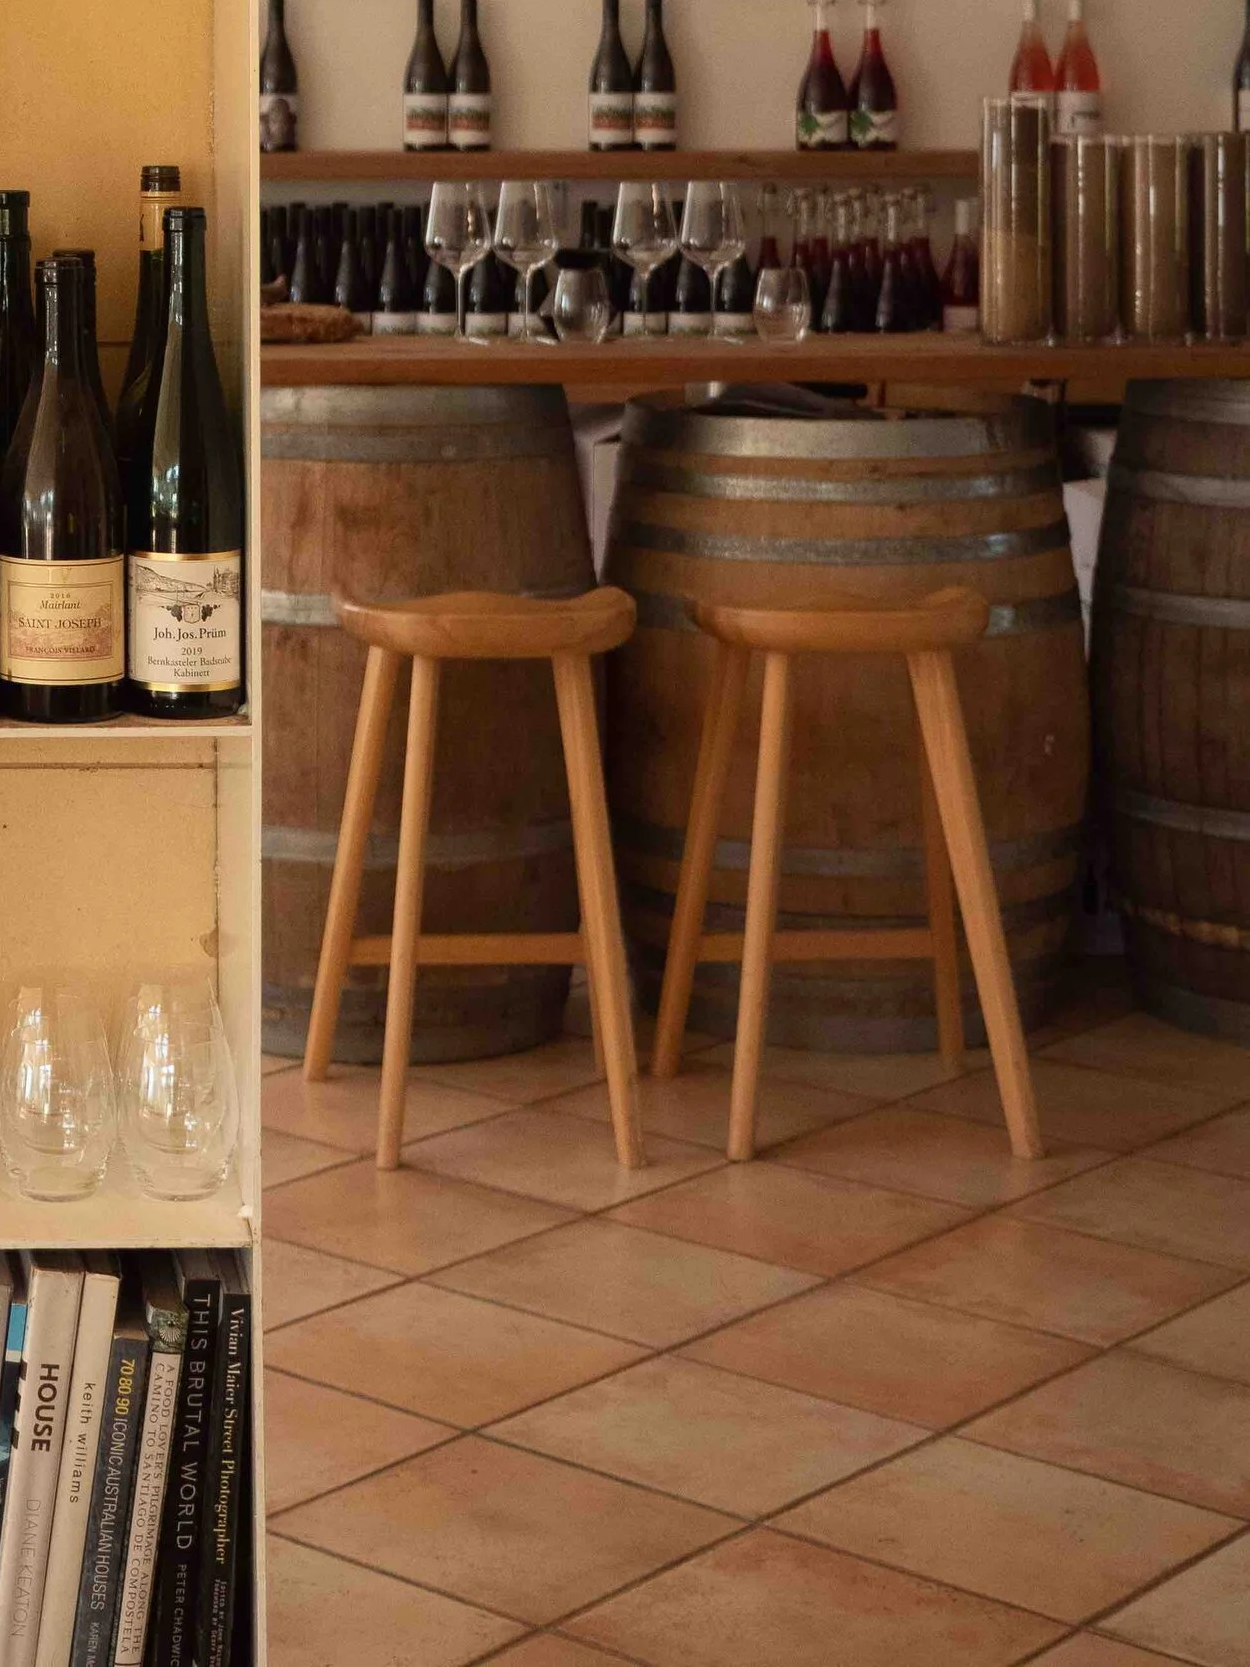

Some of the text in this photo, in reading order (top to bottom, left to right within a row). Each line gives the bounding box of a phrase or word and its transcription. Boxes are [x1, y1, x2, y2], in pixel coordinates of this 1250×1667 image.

[18, 616, 101, 630] SAINT JOSEPH
[153, 627, 227, 642] Joh. Jos. Prüm
[181, 647, 203, 656] 2019
[148, 655, 198, 667] Bernkasteler
[173, 668, 211, 677] Kabinett
[227, 1308, 245, 1355] Vivian
[30, 1363, 60, 1453] HOUSE
[223, 1357, 242, 1405] Maier
[69, 1381, 96, 1504] keith williams
[173, 1293, 211, 1605] THIS BRUTAL WORLD PETER
[221, 1408, 238, 1453] Street
[90, 1467, 121, 1611] AUSTRALIAN HOUSES
[120, 1362, 165, 1654] CAMINO COMPOSTELA
[143, 1485, 162, 1565] PILGRIMAGE
[214, 1460, 236, 1565] Photographer
[11, 1499, 41, 1638] DIANE KEATON
